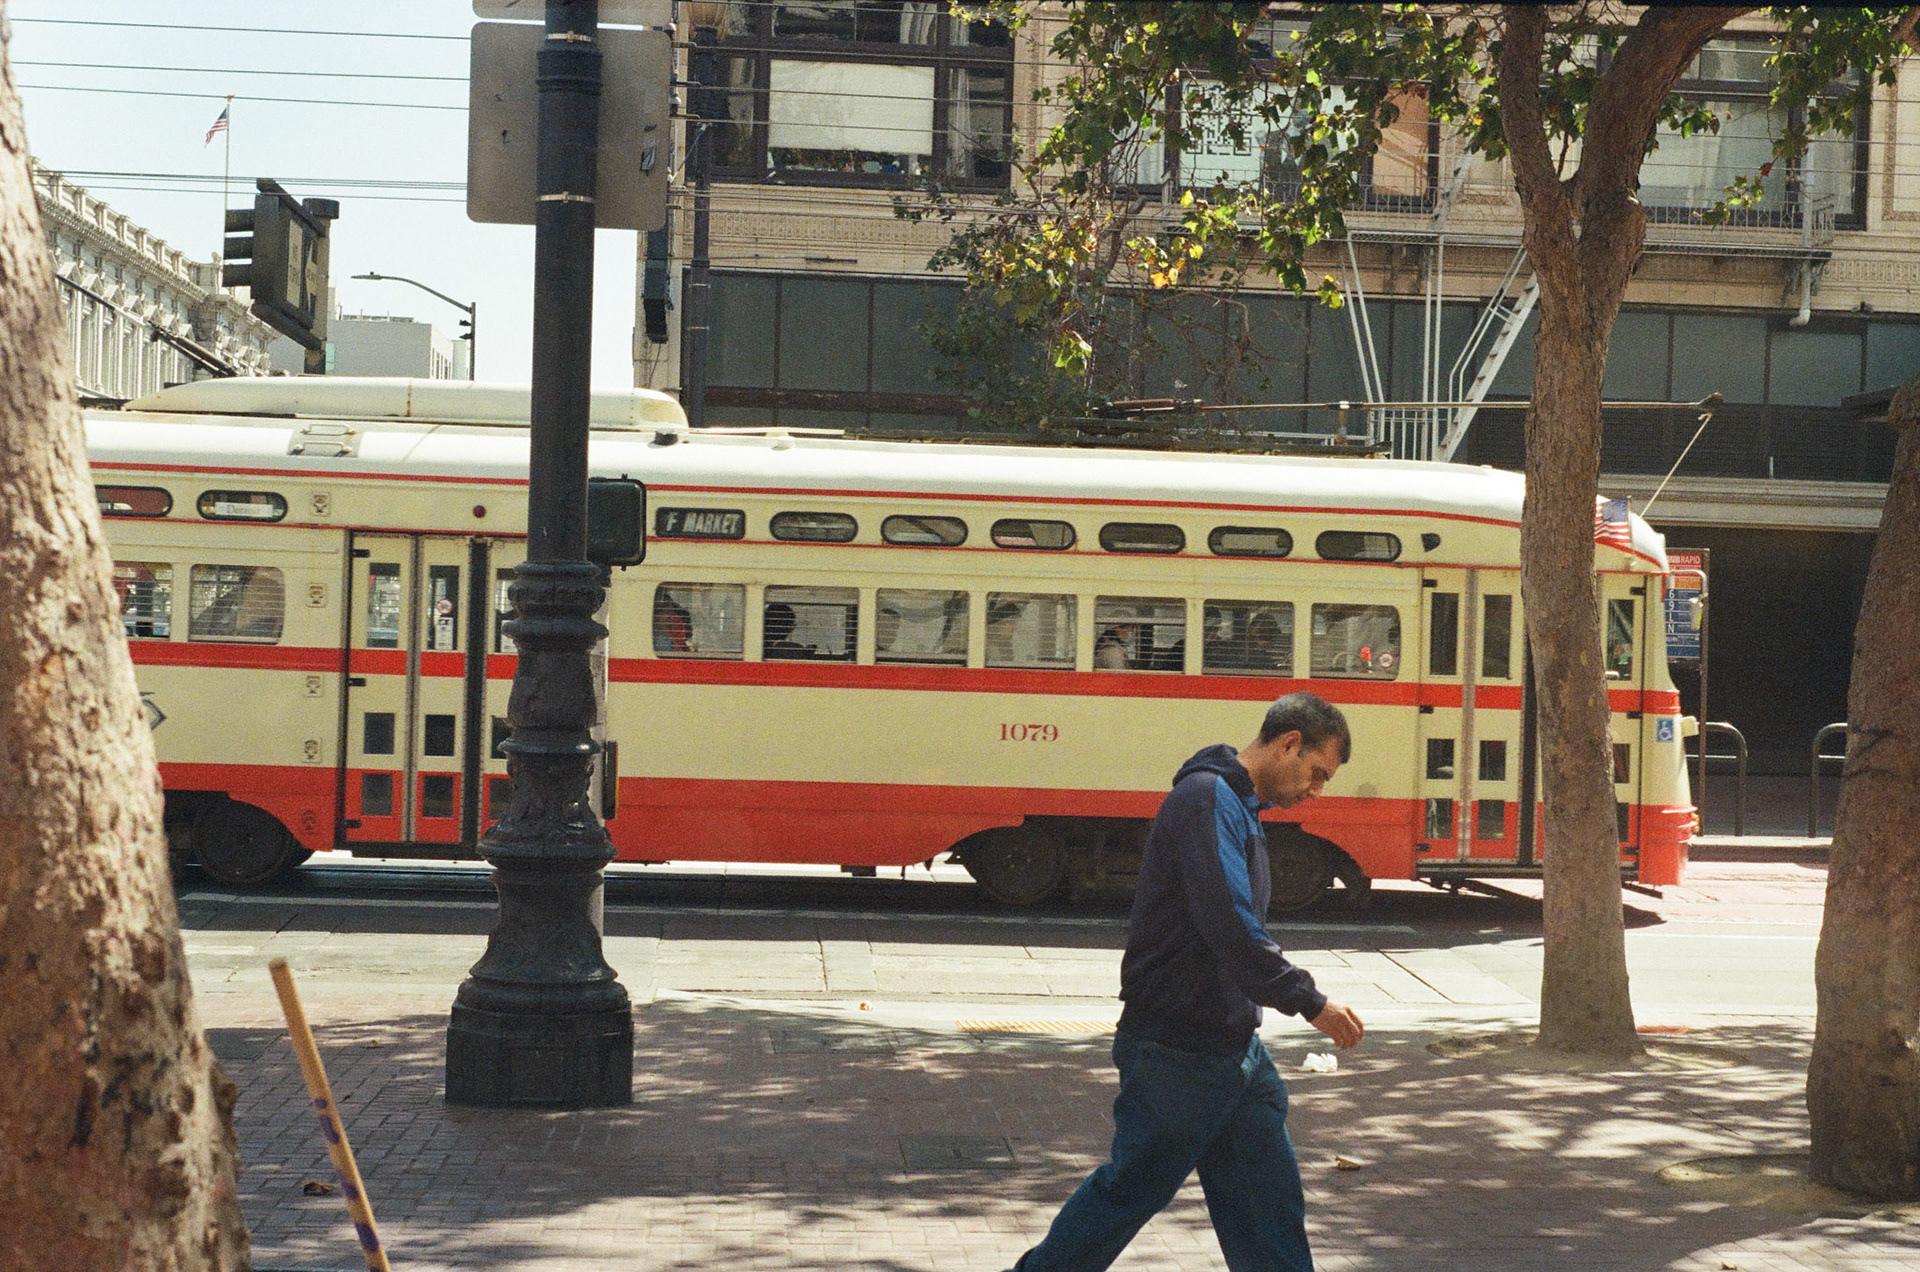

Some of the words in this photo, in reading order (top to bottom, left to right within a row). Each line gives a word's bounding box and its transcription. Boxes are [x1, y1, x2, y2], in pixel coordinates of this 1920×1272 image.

[666, 512, 678, 532] F
[682, 512, 741, 534] MARKET
[1680, 556, 1701, 564] RAPID
[1669, 590, 1675, 599] 6
[1668, 601, 1675, 610] 9
[1668, 624, 1674, 634] N
[1000, 723, 1059, 742] 1079
